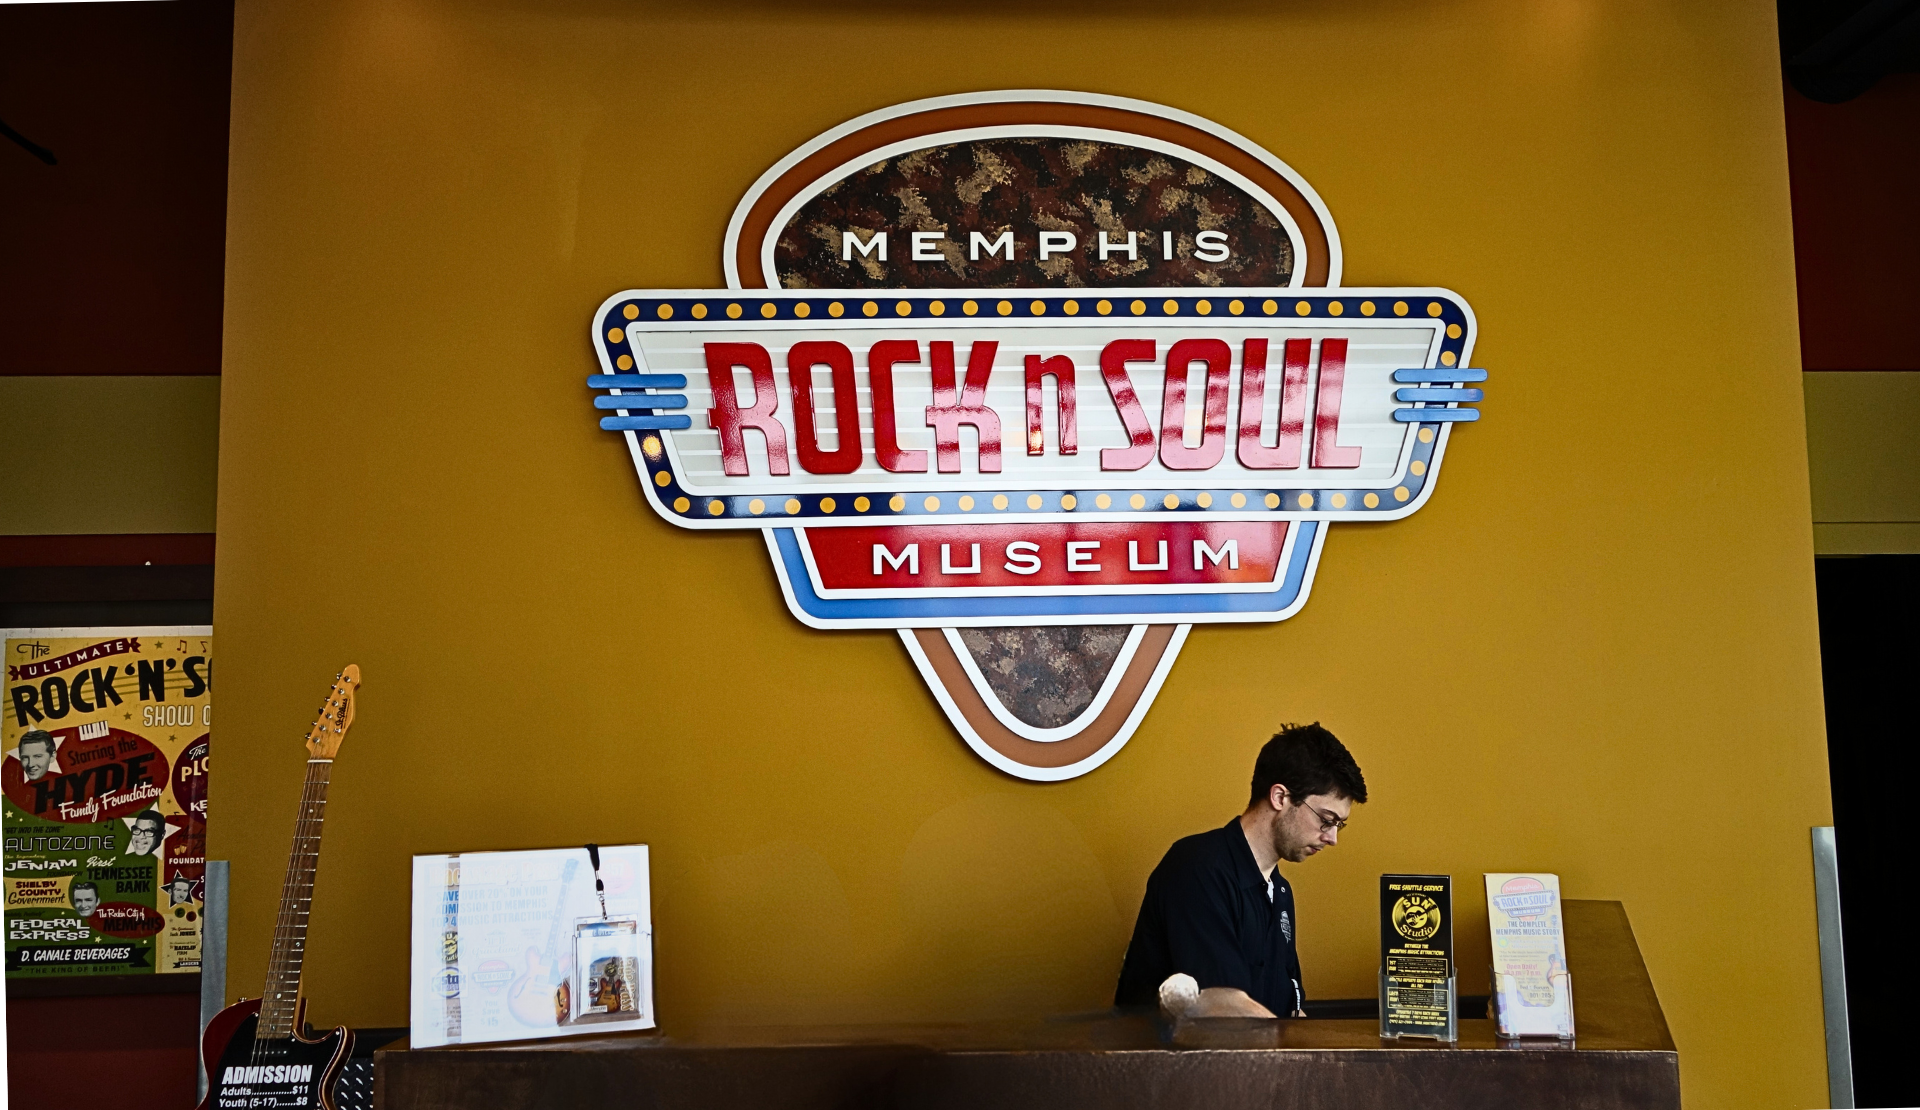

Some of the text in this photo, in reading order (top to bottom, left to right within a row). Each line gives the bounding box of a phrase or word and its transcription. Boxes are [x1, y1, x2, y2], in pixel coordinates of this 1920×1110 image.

[841, 230, 1232, 263] MEMPHIS
[702, 337, 1363, 477] ROCK n SOUL
[872, 539, 1240, 576] MUSEUM
[16, 641, 50, 660] The
[28, 641, 124, 676] ULTIMATE
[11, 665, 124, 728] ROCK
[143, 704, 194, 728] SHOW
[67, 737, 138, 766] Starring the
[31, 752, 155, 815] HYDE
[58, 782, 163, 823] Family Foundation
[4, 834, 116, 852] AUTOZONE
[4, 858, 78, 872] JENIAM
[86, 855, 118, 868] First
[87, 866, 154, 881] TENNESSEE
[15, 880, 57, 889] SHELBY
[116, 880, 151, 894] BANK
[1505, 882, 1540, 893] Memphis
[7, 891, 66, 905] Government
[18, 888, 62, 897] COUNTY
[436, 890, 460, 903] SAVE
[461, 889, 485, 901] OVER
[509, 887, 522, 899] ON
[524, 885, 548, 898] YOUR
[435, 902, 489, 915] ADMISSION
[491, 900, 502, 912] TO
[1402, 896, 1432, 910] SUN
[1500, 896, 1523, 908] ROCK
[1529, 894, 1549, 906] SOUL
[96, 908, 107, 919] The
[431, 910, 554, 929] TOP 4 MUSIC ATTRACTIONS
[9, 918, 91, 930] FEDERAL
[103, 917, 162, 932] MEMPHIS
[1400, 924, 1434, 938] Studio
[1507, 920, 1547, 928] THE COMPLETE
[9, 929, 91, 942] EXPRESS
[1495, 928, 1560, 936] MEMPHIS MUSIC STORY
[20, 947, 131, 962] D. CANALE BEVERAGES
[221, 1064, 313, 1085] ADMISSION
[292, 1085, 309, 1095] $11
[218, 1098, 247, 1108] Youth
[296, 1096, 308, 1106] $8
